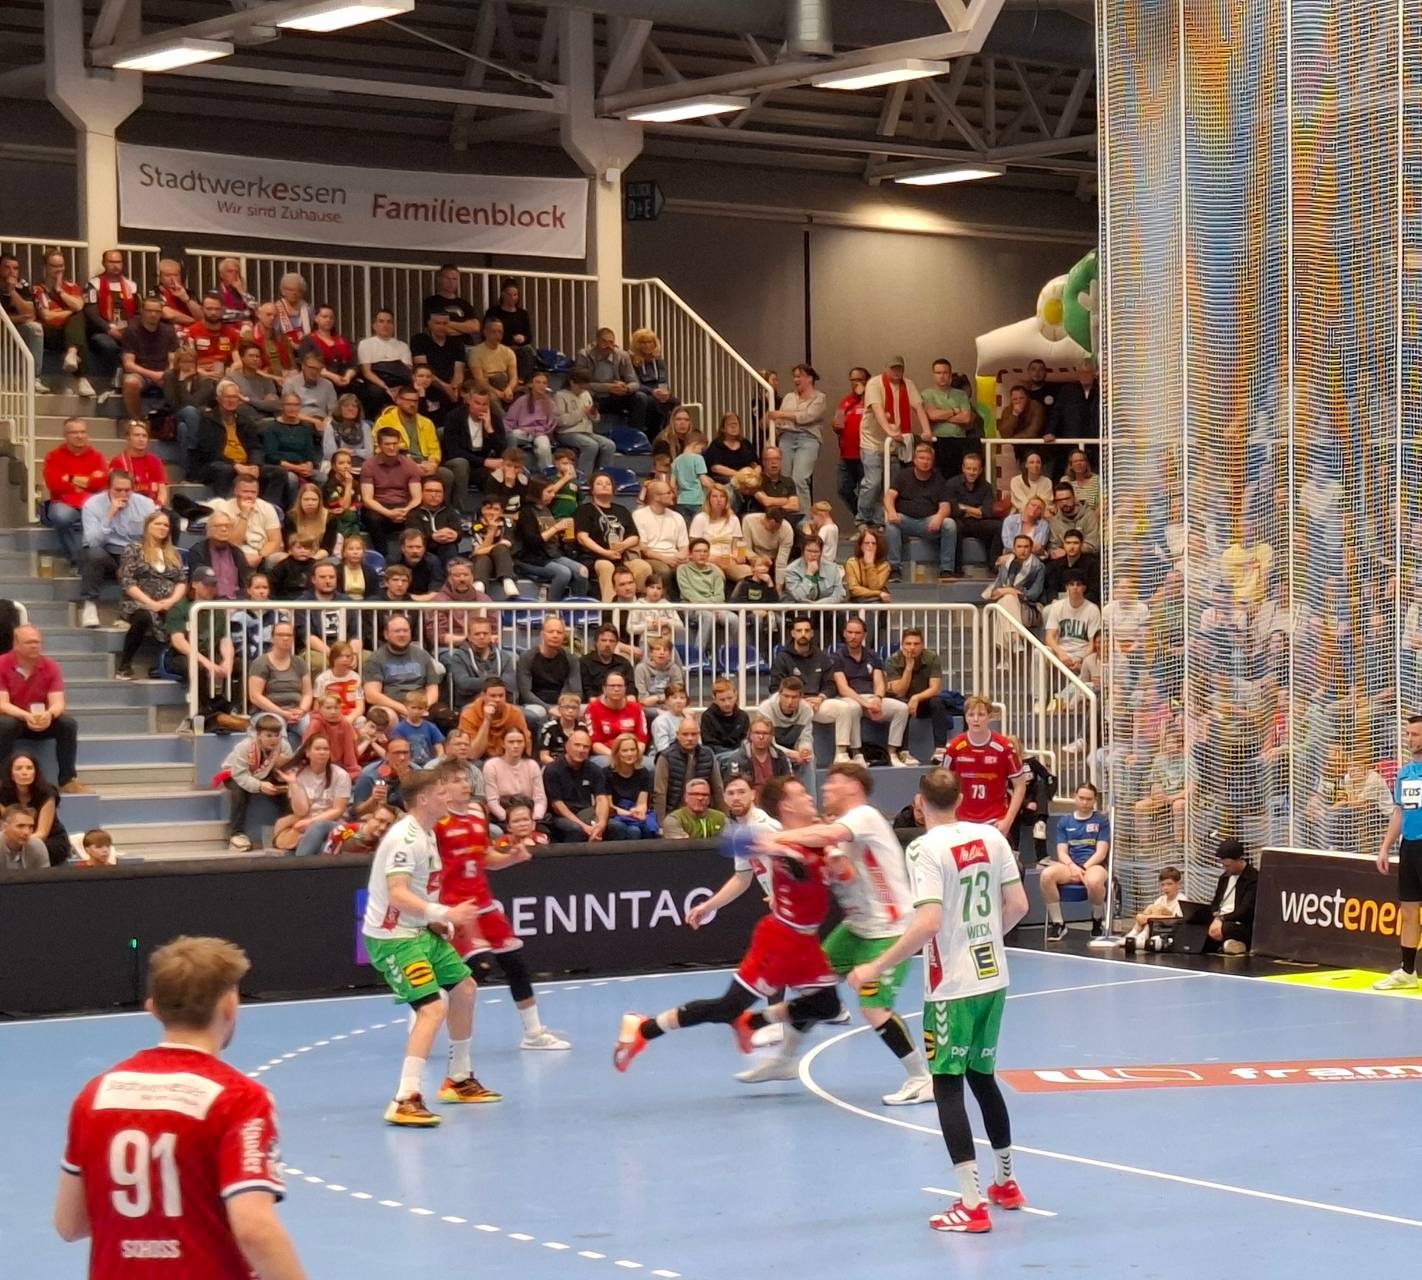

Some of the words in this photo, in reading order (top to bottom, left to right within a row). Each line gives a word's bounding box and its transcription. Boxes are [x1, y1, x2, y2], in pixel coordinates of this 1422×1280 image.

[138, 162, 348, 205] Stadtwerkessen
[217, 200, 242, 214] Wir
[247, 205, 277, 218] sind
[372, 193, 567, 229] Familienblock
[495, 887, 718, 937] ENNTAG
[960, 870, 992, 922] 73
[109, 1128, 184, 1219] 91
